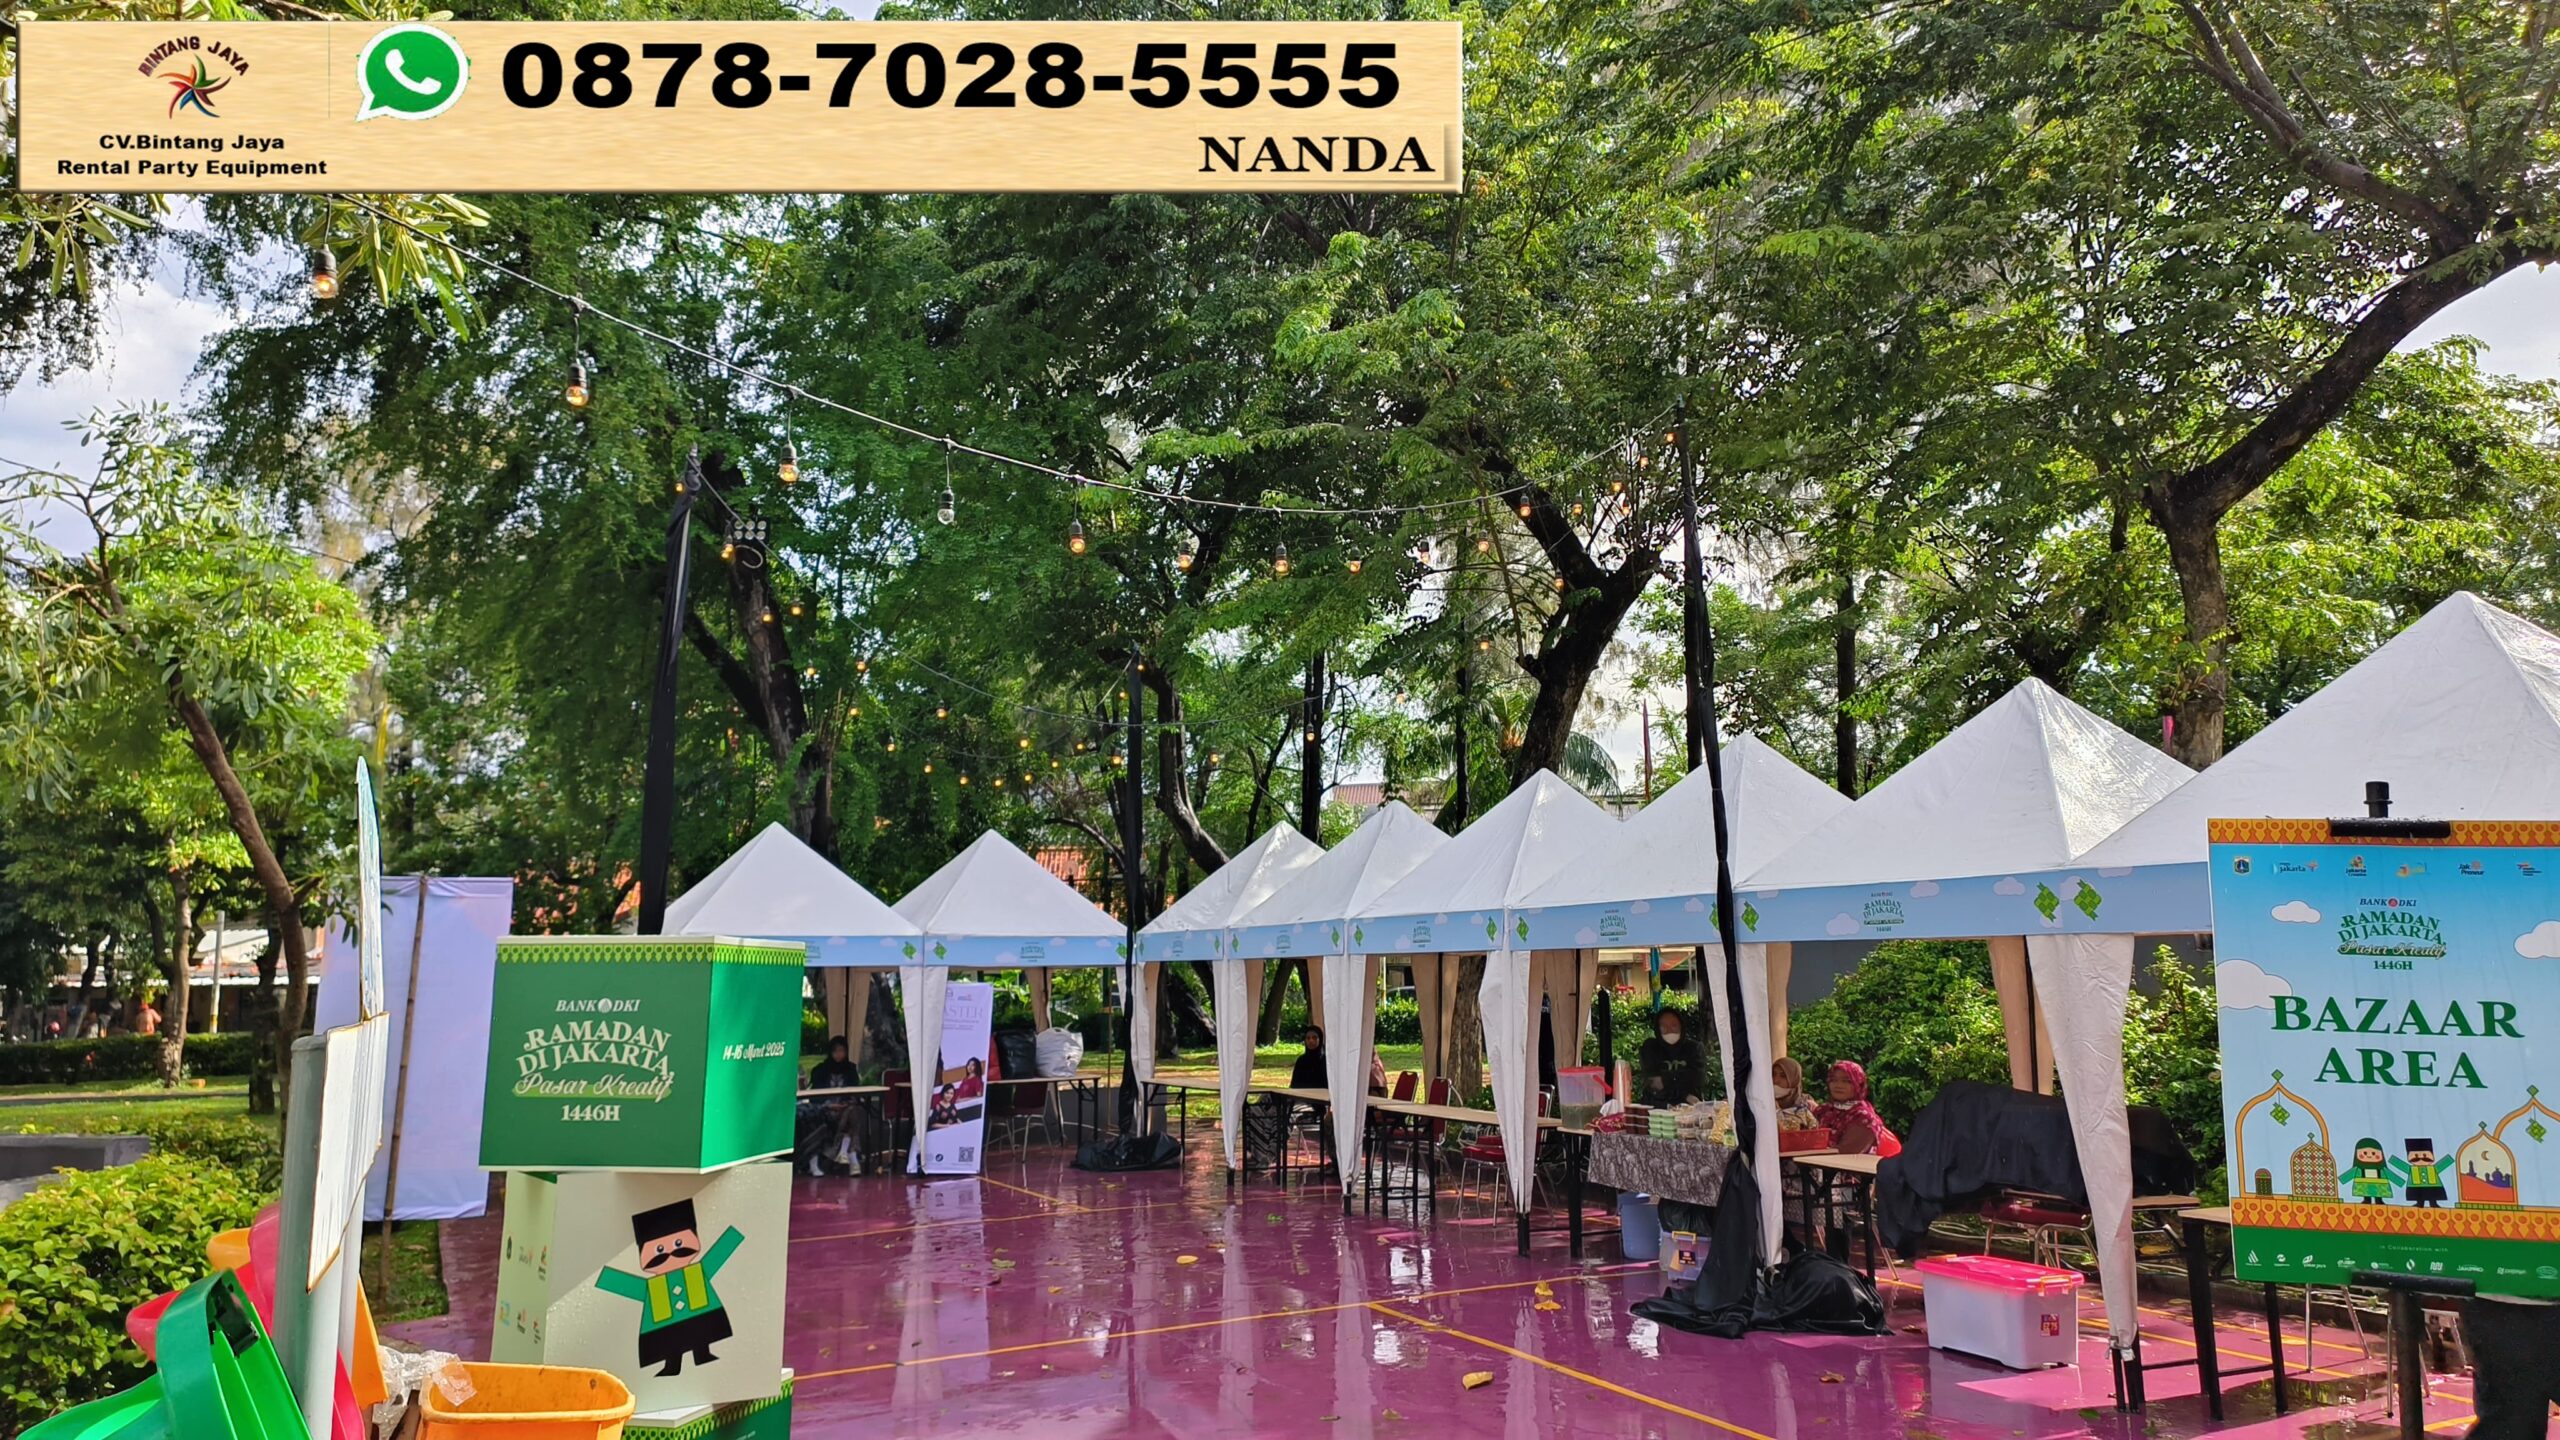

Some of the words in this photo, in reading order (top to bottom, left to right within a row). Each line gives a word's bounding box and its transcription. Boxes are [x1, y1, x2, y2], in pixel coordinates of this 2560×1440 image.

[2360, 898, 2387, 906] BANK
[2399, 899, 2417, 907] DKI
[2341, 911, 2441, 931] RAMADAN
[2338, 927, 2360, 943] DI
[2361, 924, 2447, 946] JAKARTA
[2373, 961, 2413, 970] 1446H
[555, 999, 598, 1013] BANK
[612, 999, 641, 1012] DKI
[2269, 995, 2525, 1038] BAZAAR
[523, 1019, 671, 1051] RAMADAN
[516, 1050, 549, 1077] DI
[552, 1041, 675, 1079] JAKARTA
[2314, 1046, 2488, 1089] AREA
[515, 1072, 587, 1096] Pasar
[593, 1073, 674, 1103] Kreatif
[560, 1104, 621, 1121] 1446H
